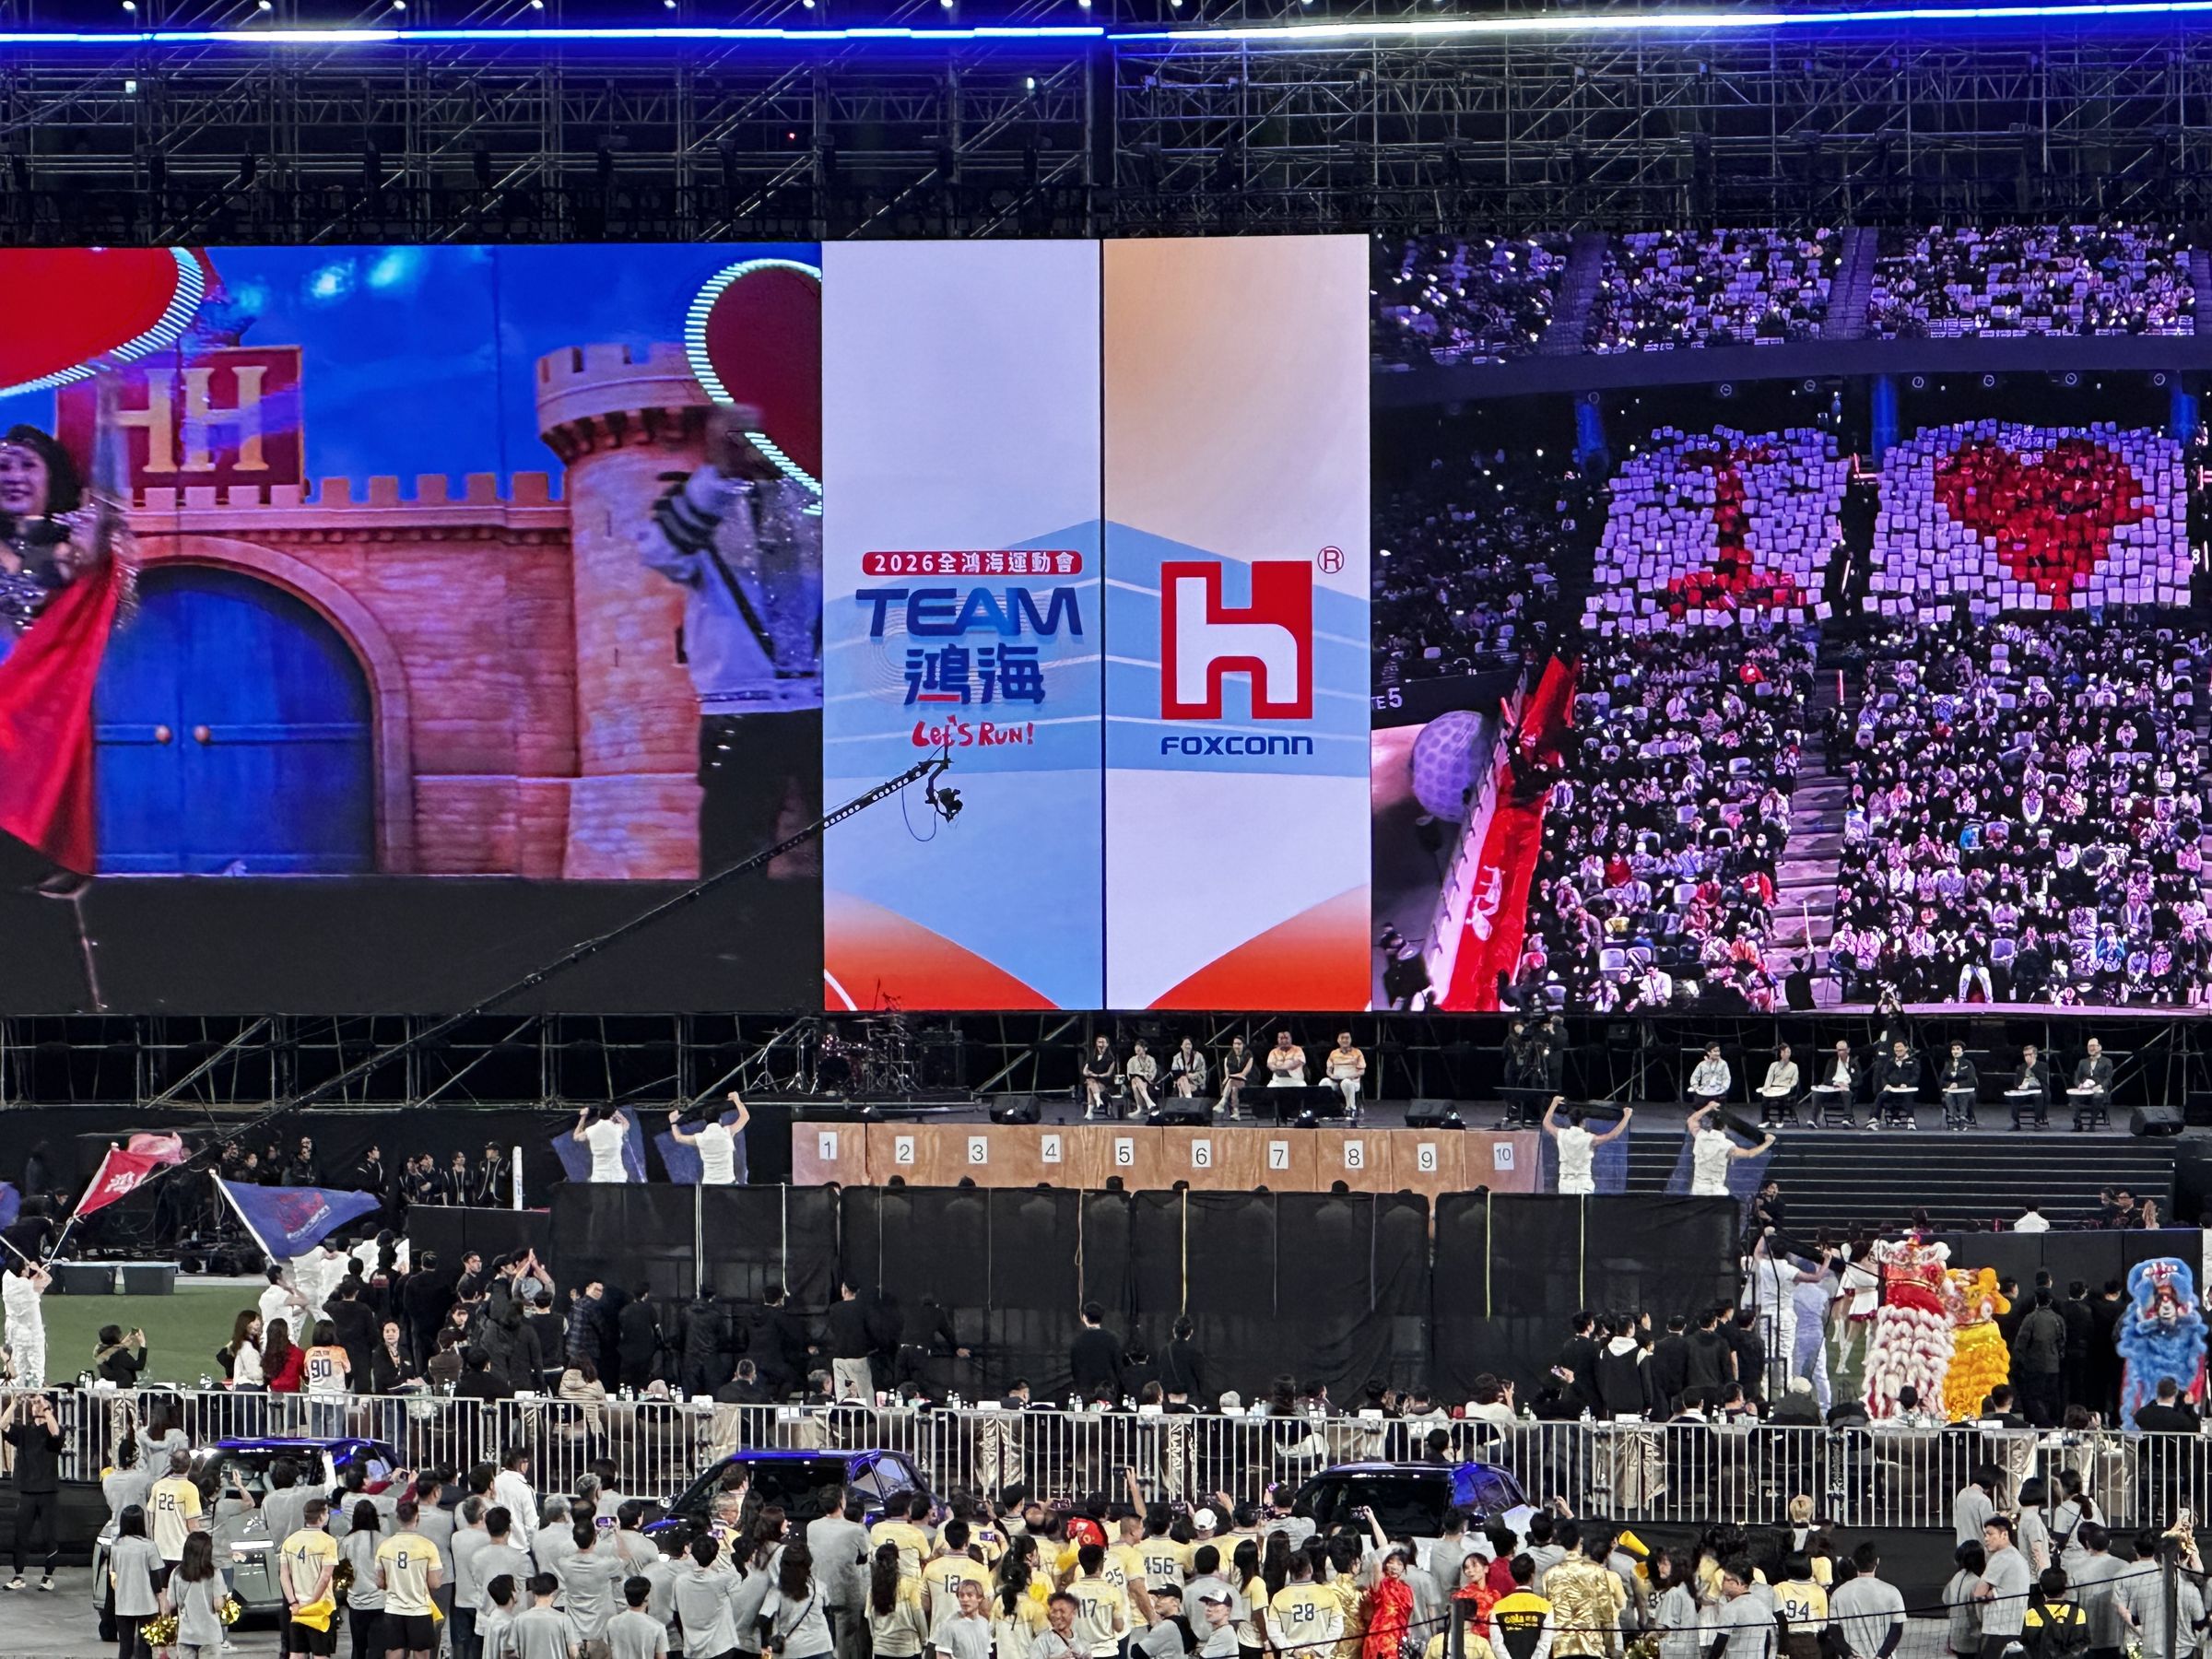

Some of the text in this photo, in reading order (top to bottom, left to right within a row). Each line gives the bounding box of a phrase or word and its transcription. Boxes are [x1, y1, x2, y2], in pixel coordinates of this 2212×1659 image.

[875, 552, 1075, 573] 2026全鴻海運動會
[855, 587, 1084, 638] TEAM
[903, 642, 1046, 706] 鴻海
[823, 1141, 831, 1159] 1
[899, 1144, 911, 1161] 2
[971, 1144, 984, 1161] 3
[1044, 1143, 1057, 1157] 4
[1119, 1146, 1131, 1163] 5
[1195, 1147, 1207, 1166] 6
[1273, 1148, 1284, 1166] 7
[1347, 1147, 1360, 1166] 8
[1495, 1147, 1512, 1161] 10
[1421, 1151, 1433, 1169] 9
[311, 1359, 332, 1378] 90
[159, 1492, 175, 1511] 22
[297, 1546, 305, 1564] 4
[397, 1551, 407, 1569] 8
[1292, 1603, 1314, 1623] 28
[1785, 1599, 1809, 1621] 94
